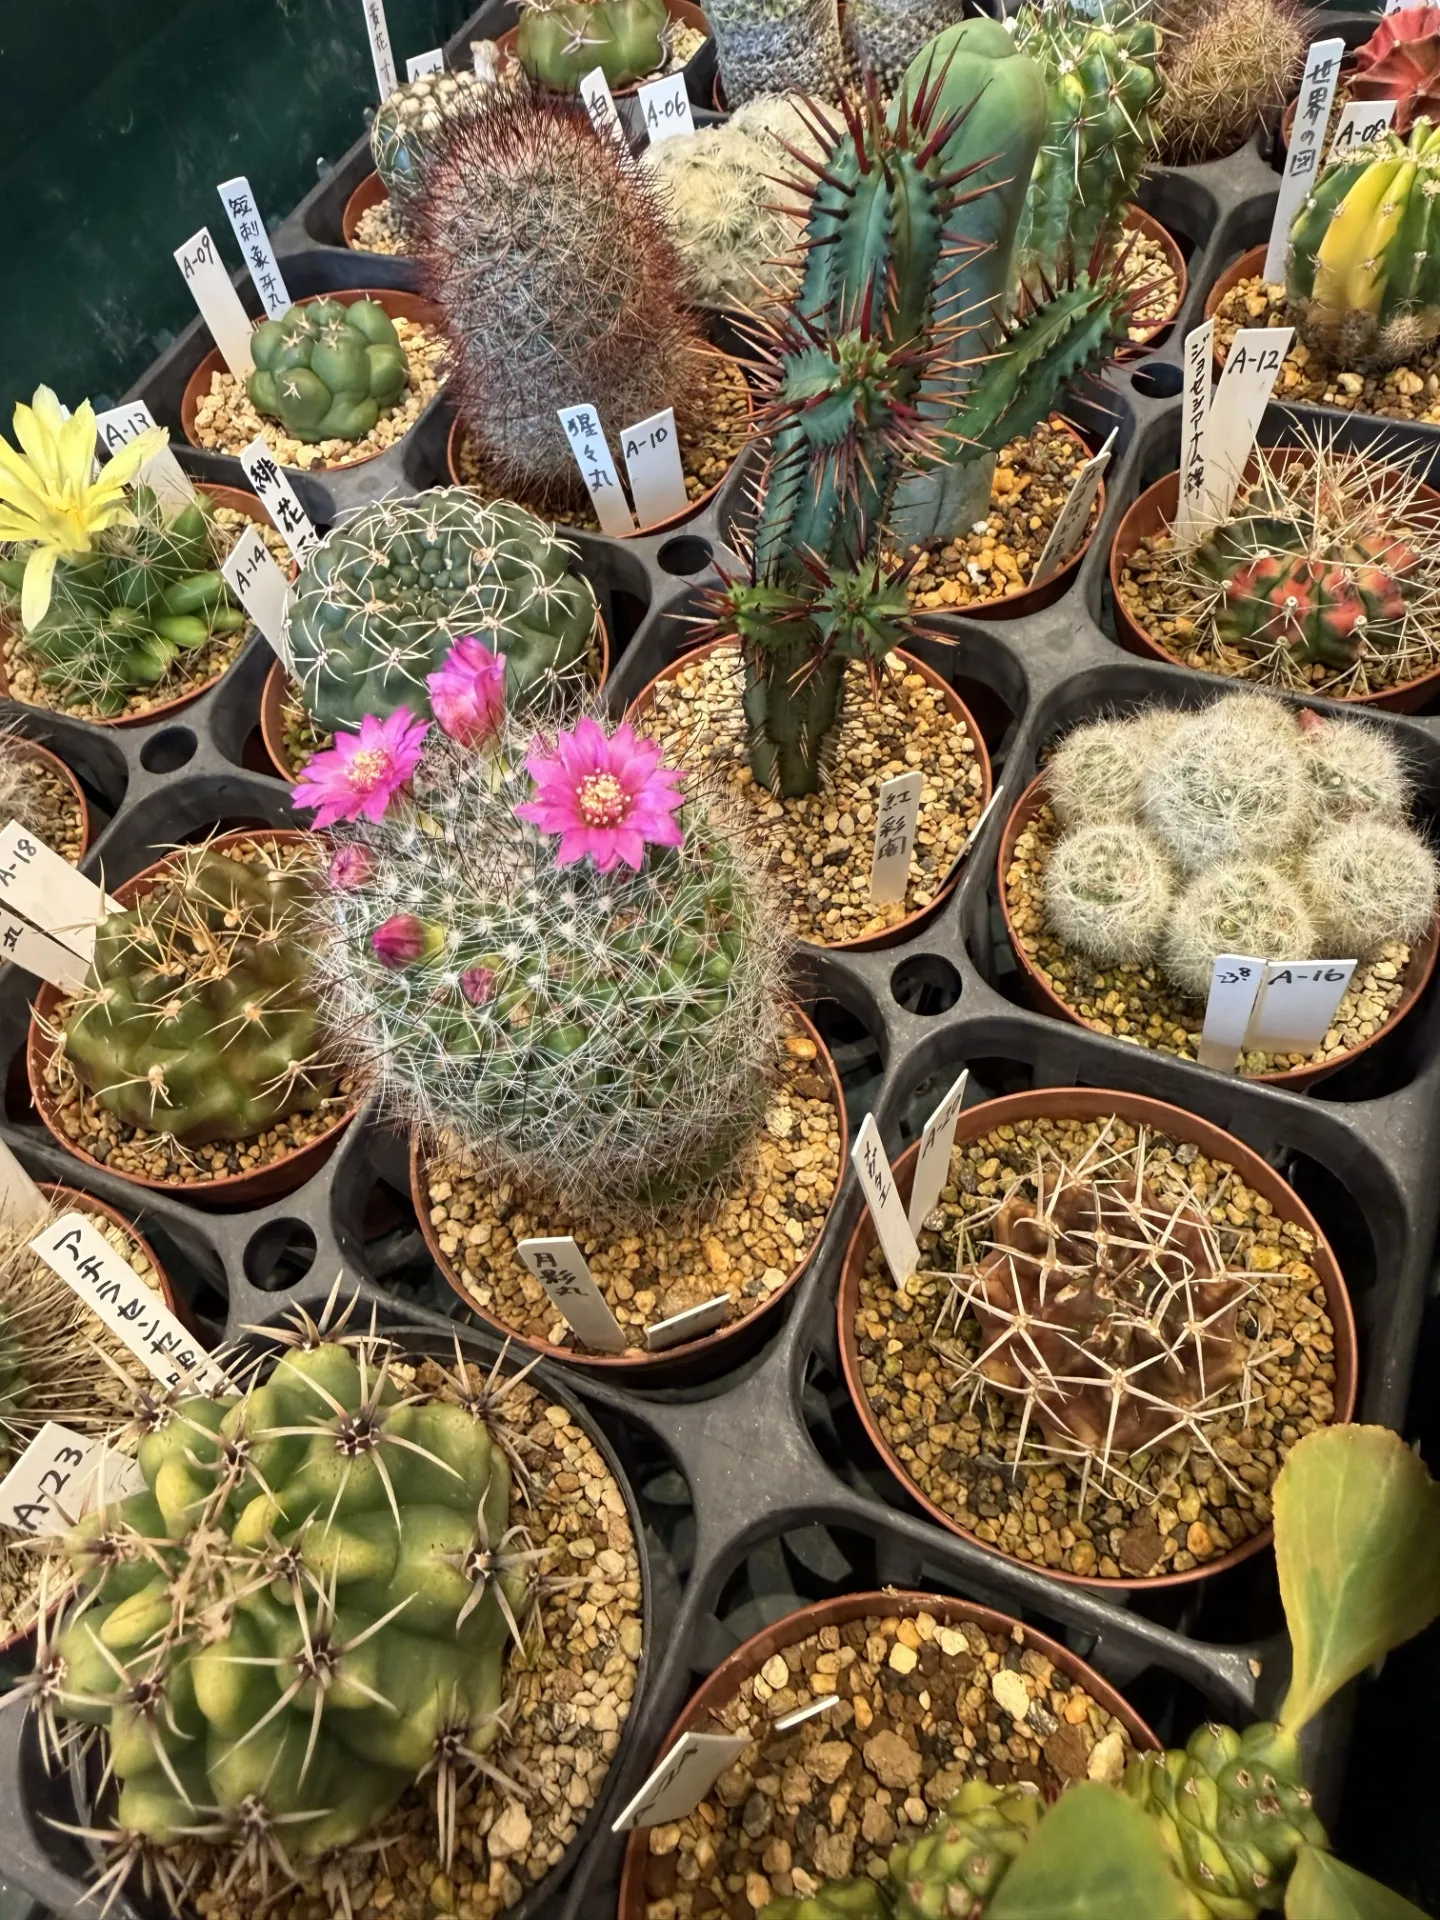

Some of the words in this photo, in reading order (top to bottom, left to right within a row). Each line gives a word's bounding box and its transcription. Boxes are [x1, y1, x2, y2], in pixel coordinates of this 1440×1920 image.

[647, 91, 686, 128] A-06
[1290, 58, 1333, 178] 世界の図
[183, 235, 214, 279] A-09
[1228, 347, 1279, 374] A-12
[567, 413, 613, 492] 猩々丸
[626, 427, 668, 458] A-10
[236, 545, 266, 594] A-14
[1267, 968, 1346, 986] A-16
[13, 1446, 83, 1530] A-23
